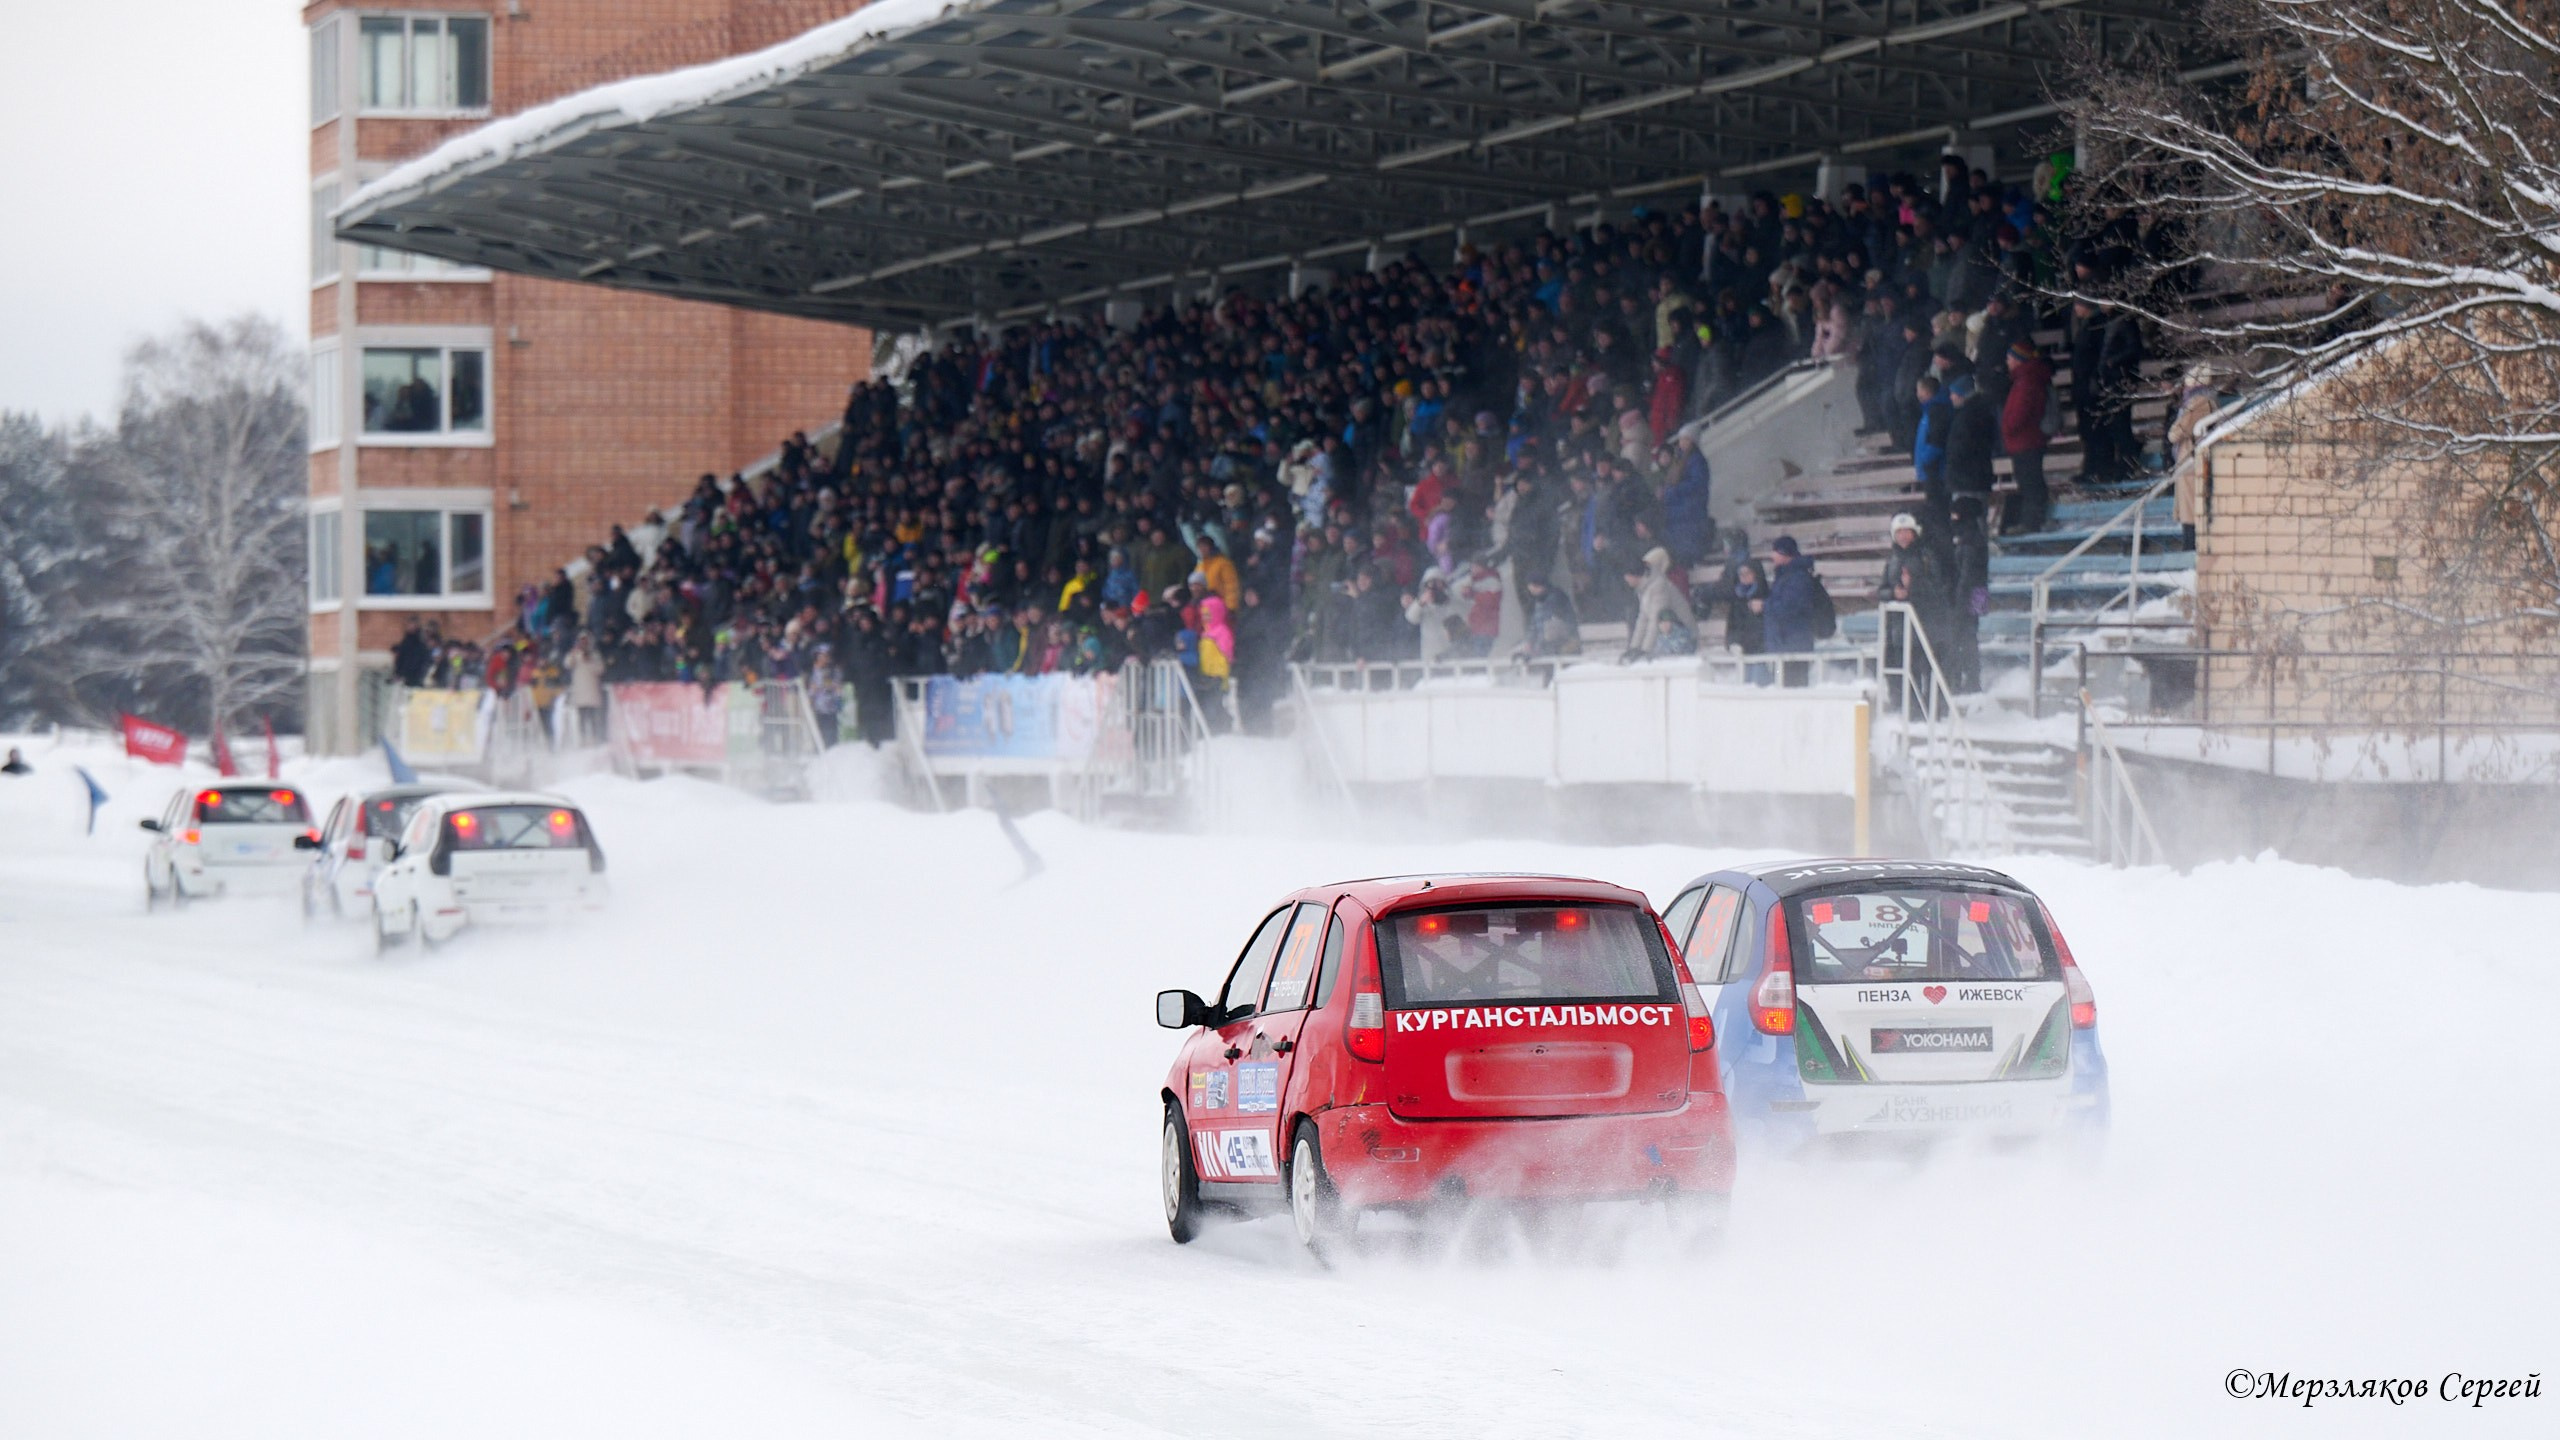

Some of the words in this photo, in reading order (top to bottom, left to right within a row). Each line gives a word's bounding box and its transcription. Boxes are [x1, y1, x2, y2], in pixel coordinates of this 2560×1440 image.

[1688, 895, 1735, 960] 58
[1282, 923, 1315, 977] 77
[1858, 990, 1912, 1002] ПЕНЗА
[1959, 989, 2024, 1001] ИЖЕВСК
[1395, 1006, 1674, 1033] КУРГАНСТАЛЬМОСТ
[1903, 1033, 1988, 1048] YOKOHAMA
[1893, 1096, 1928, 1107] БАНК
[1893, 1100, 2013, 1123] КУЗНЕЦКИЙ
[1227, 1136, 1246, 1168] 45
